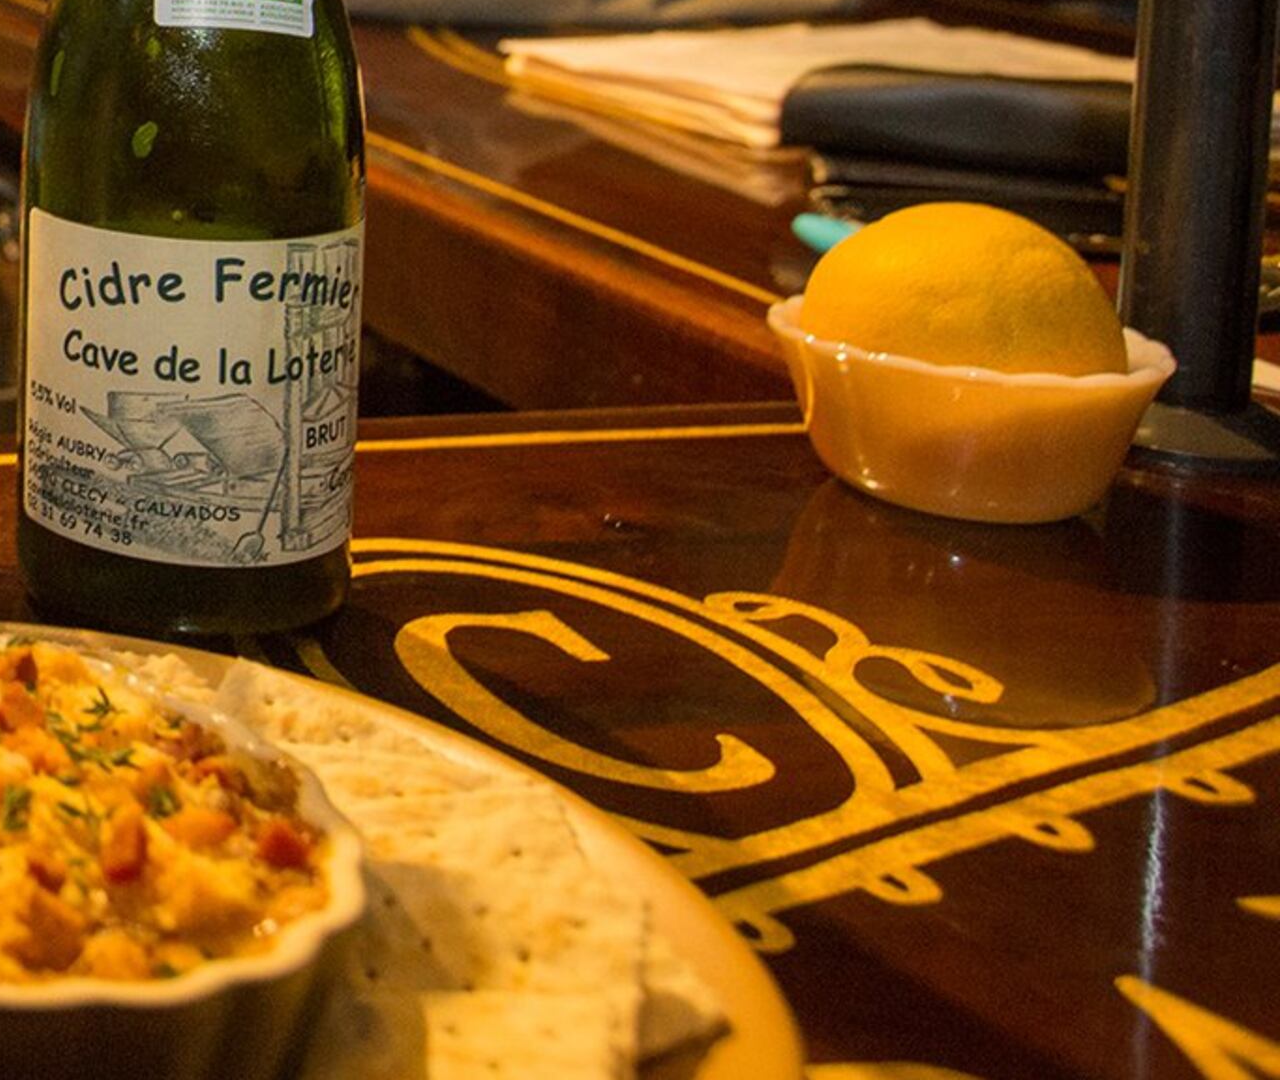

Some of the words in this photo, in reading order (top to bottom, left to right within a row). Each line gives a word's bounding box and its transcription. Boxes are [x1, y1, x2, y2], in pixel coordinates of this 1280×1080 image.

[58, 260, 186, 311] Cidre
[62, 328, 139, 376] Cave
[153, 344, 201, 384] de
[218, 346, 253, 386] la
[55, 392, 77, 415] Vol
[56, 435, 107, 463] AUBRY
[305, 415, 347, 449] BRUT
[41, 502, 54, 521] 31
[60, 510, 77, 530] 69
[83, 519, 103, 539] 74
[109, 527, 132, 546] 38
[133, 497, 241, 524] CALVADOS
